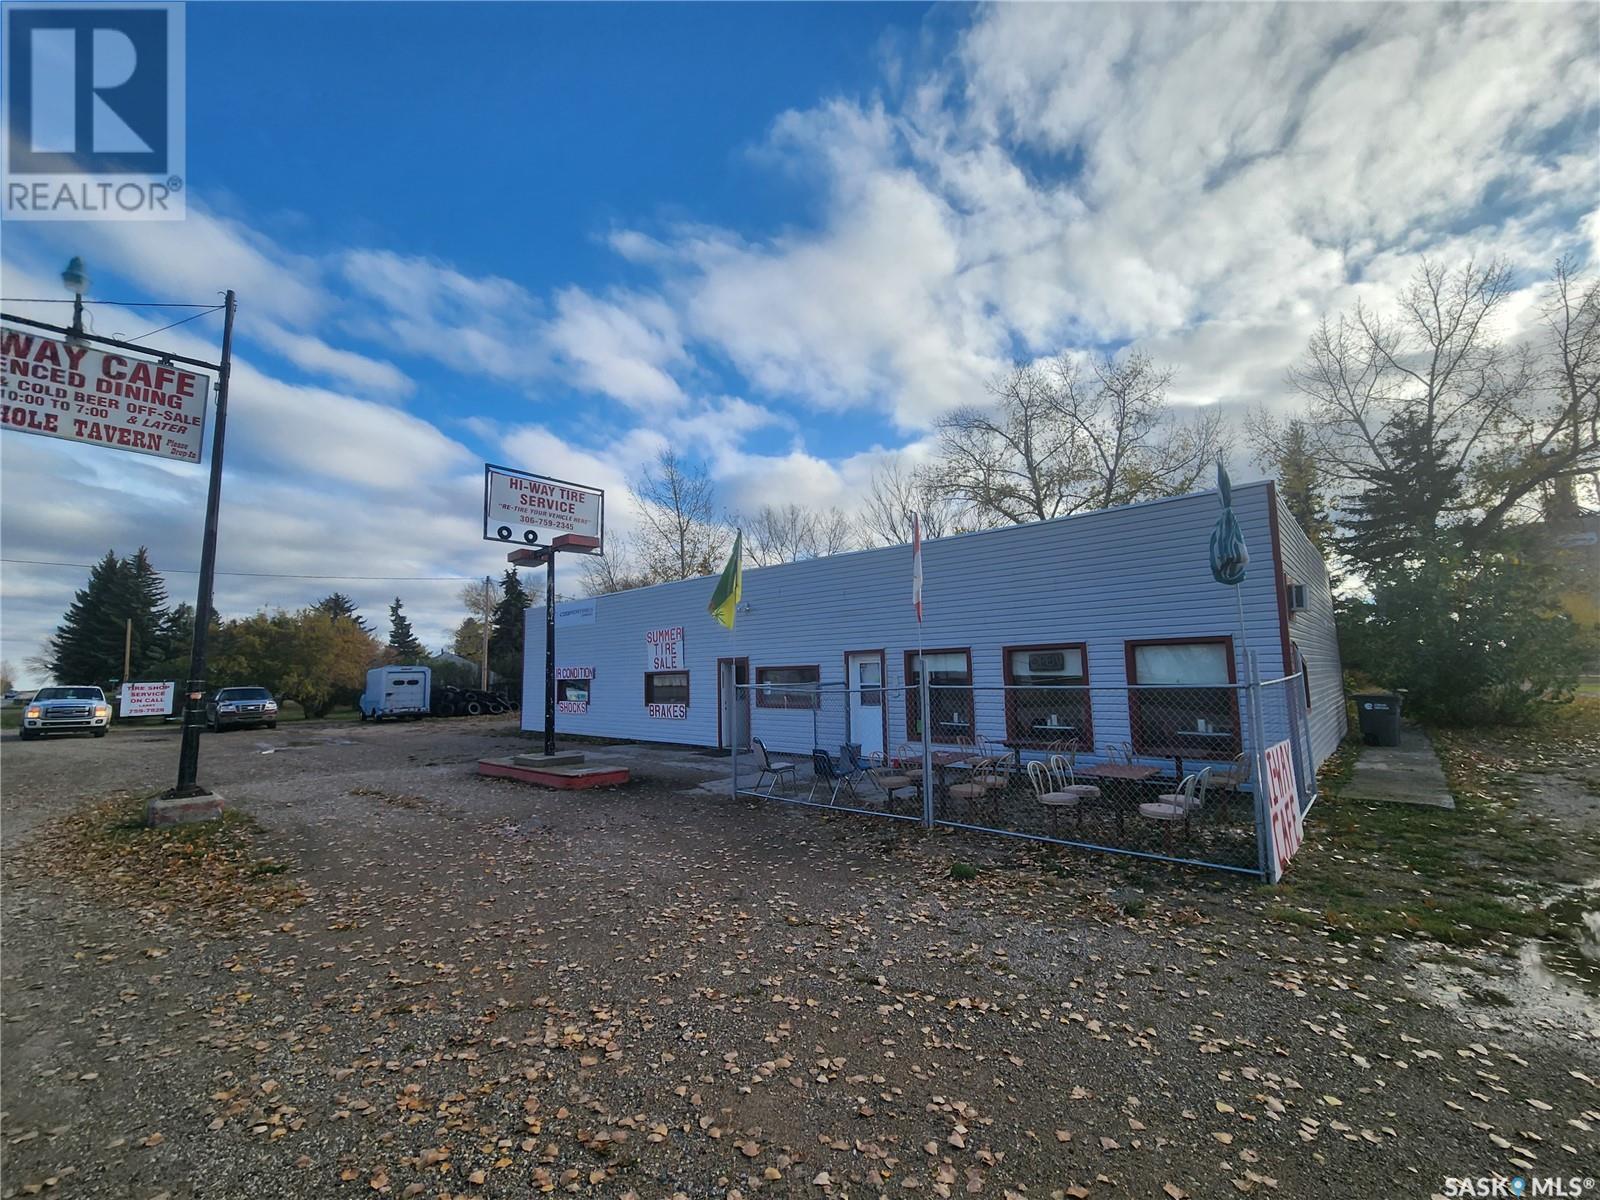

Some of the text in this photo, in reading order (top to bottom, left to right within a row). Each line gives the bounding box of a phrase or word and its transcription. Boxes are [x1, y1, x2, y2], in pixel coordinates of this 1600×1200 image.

[102, 354, 197, 398] CAFE
[1, 388, 109, 419] 10:00 TO 7:00
[17, 380, 68, 399] COLD
[74, 392, 120, 410] BEER
[127, 403, 201, 426] OFF-SALE
[96, 377, 183, 410] DINING
[73, 418, 162, 451] TAVERN
[126, 414, 188, 435] & LATER
[510, 477, 585, 504] HI-WAY TIRE
[520, 494, 575, 514] SERVICE
[520, 515, 574, 531] 306-759-2345
[530, 508, 547, 517] YOUR
[548, 512, 572, 522] VEHICLE
[646, 627, 682, 643] SUMMER
[654, 642, 677, 656] TIRE
[653, 656, 677, 670] SALE
[560, 702, 586, 712] SHOCKS
[650, 704, 686, 718] BRAKES
